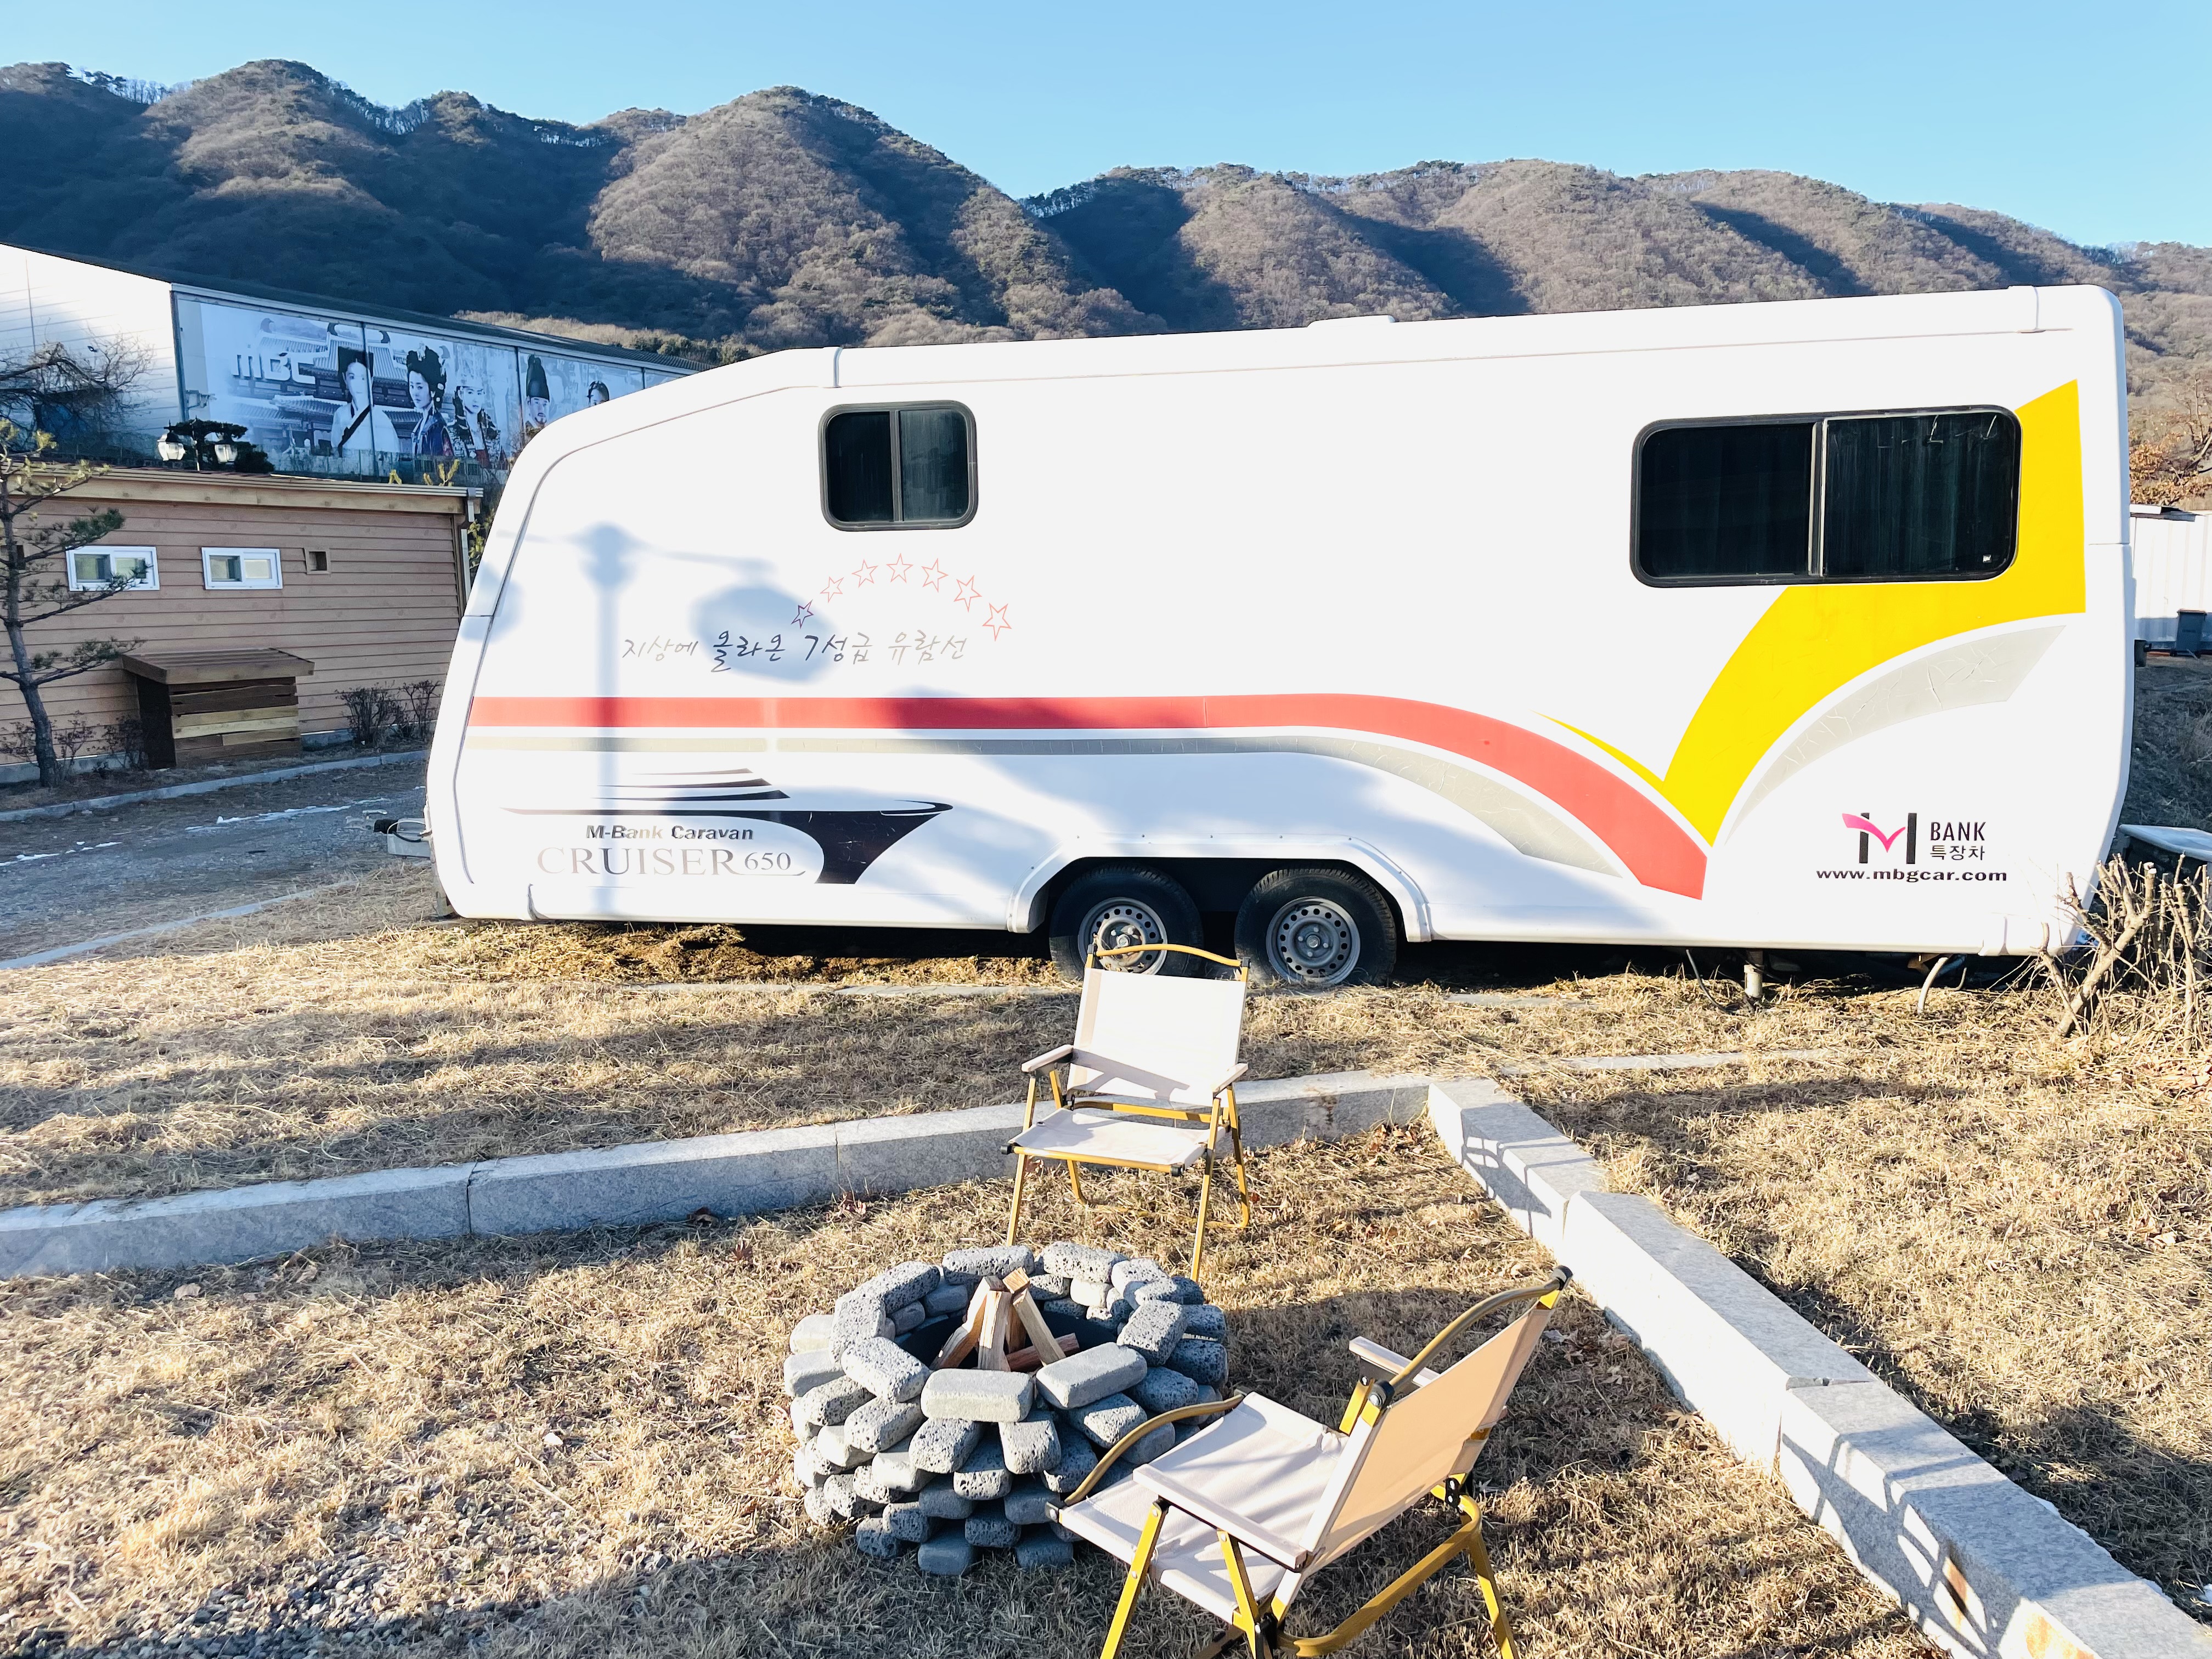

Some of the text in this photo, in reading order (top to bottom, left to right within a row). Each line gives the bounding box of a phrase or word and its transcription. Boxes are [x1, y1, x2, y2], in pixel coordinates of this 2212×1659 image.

[622, 629, 967, 673] 지상에 올라온 7성급 유람선
[585, 825, 754, 840] M-Bank Caravan
[1930, 821, 1987, 841] BANK
[537, 847, 792, 876] CRUISER 650
[1929, 845, 1985, 861] 특장차
[1816, 868, 2007, 883] www.mbgcar.com
